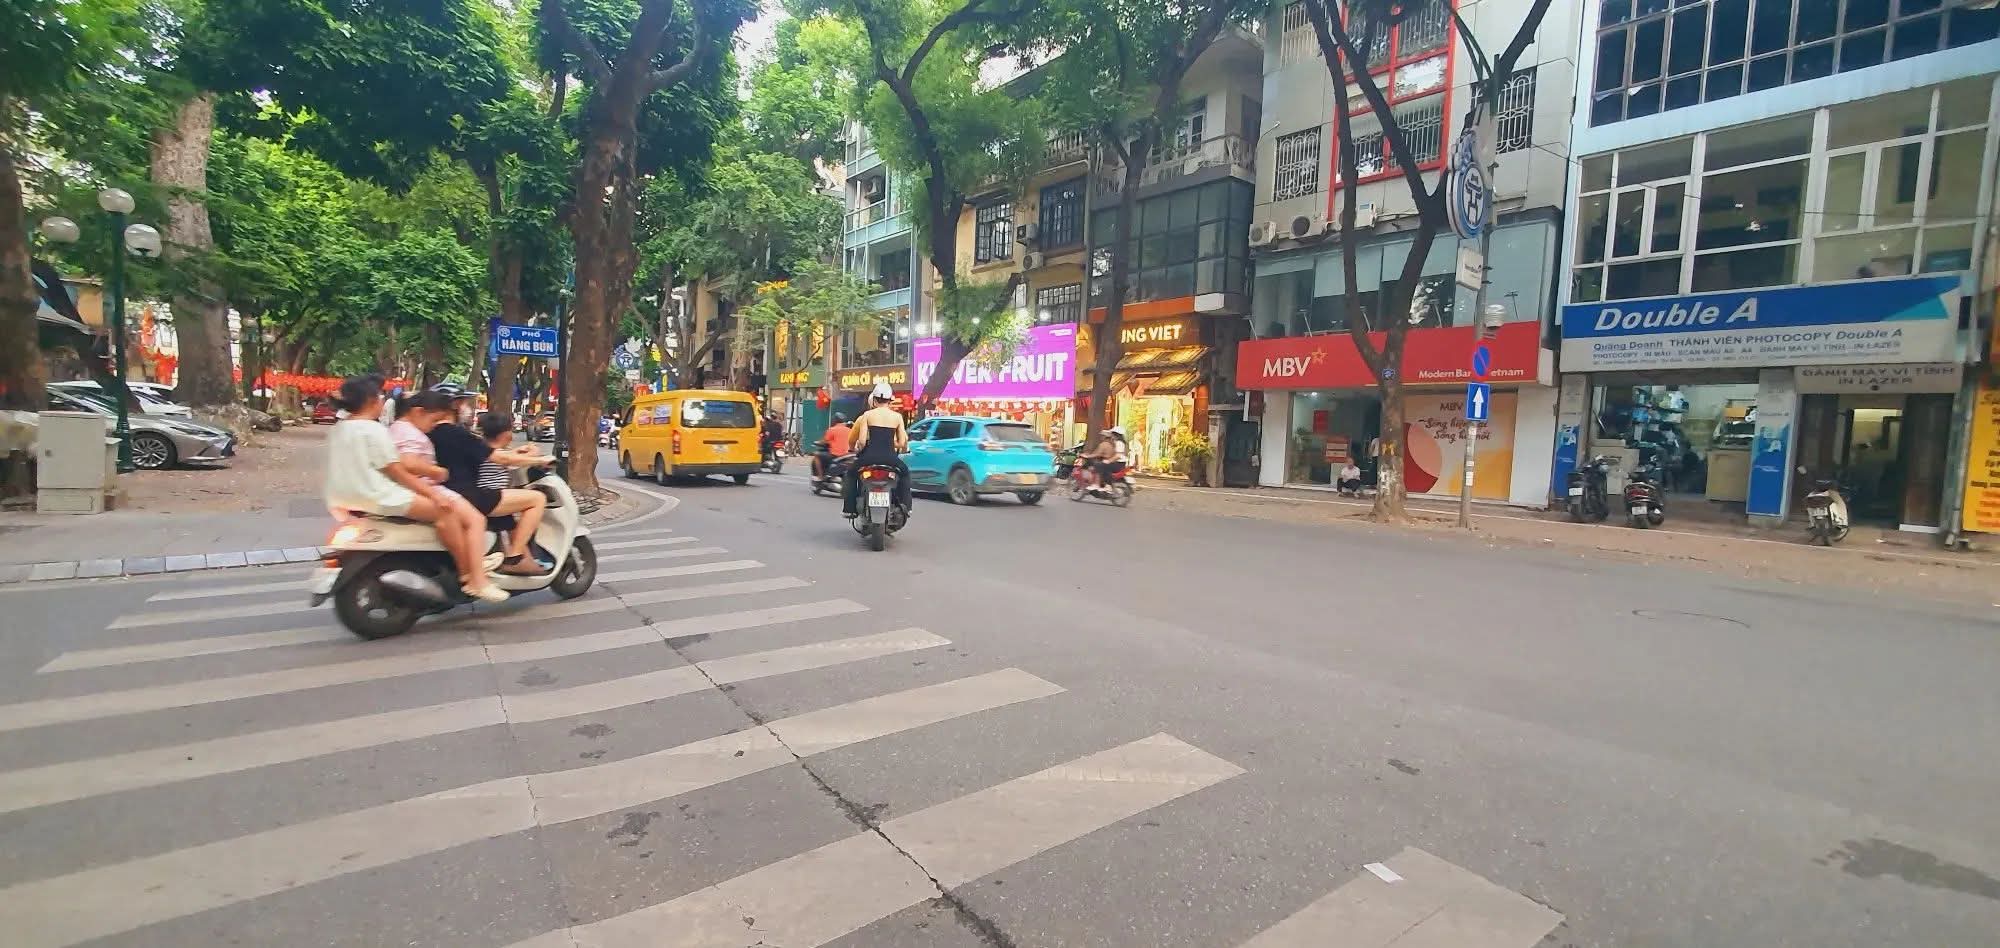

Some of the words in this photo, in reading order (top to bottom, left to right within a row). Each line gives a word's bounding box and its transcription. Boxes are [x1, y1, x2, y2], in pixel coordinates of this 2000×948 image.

[1594, 301, 1720, 331] Double
[1726, 297, 1758, 323] A
[1149, 324, 1182, 340] VIET
[1746, 332, 1831, 343] PHOTOCOPY
[1836, 330, 1888, 340] Double
[1891, 328, 1902, 337] A
[502, 338, 530, 351] HÀNG
[533, 340, 553, 352] BÚN
[1263, 356, 1311, 377] MBV
[1418, 369, 1454, 379] Modern
[1440, 402, 1463, 411] MBV
